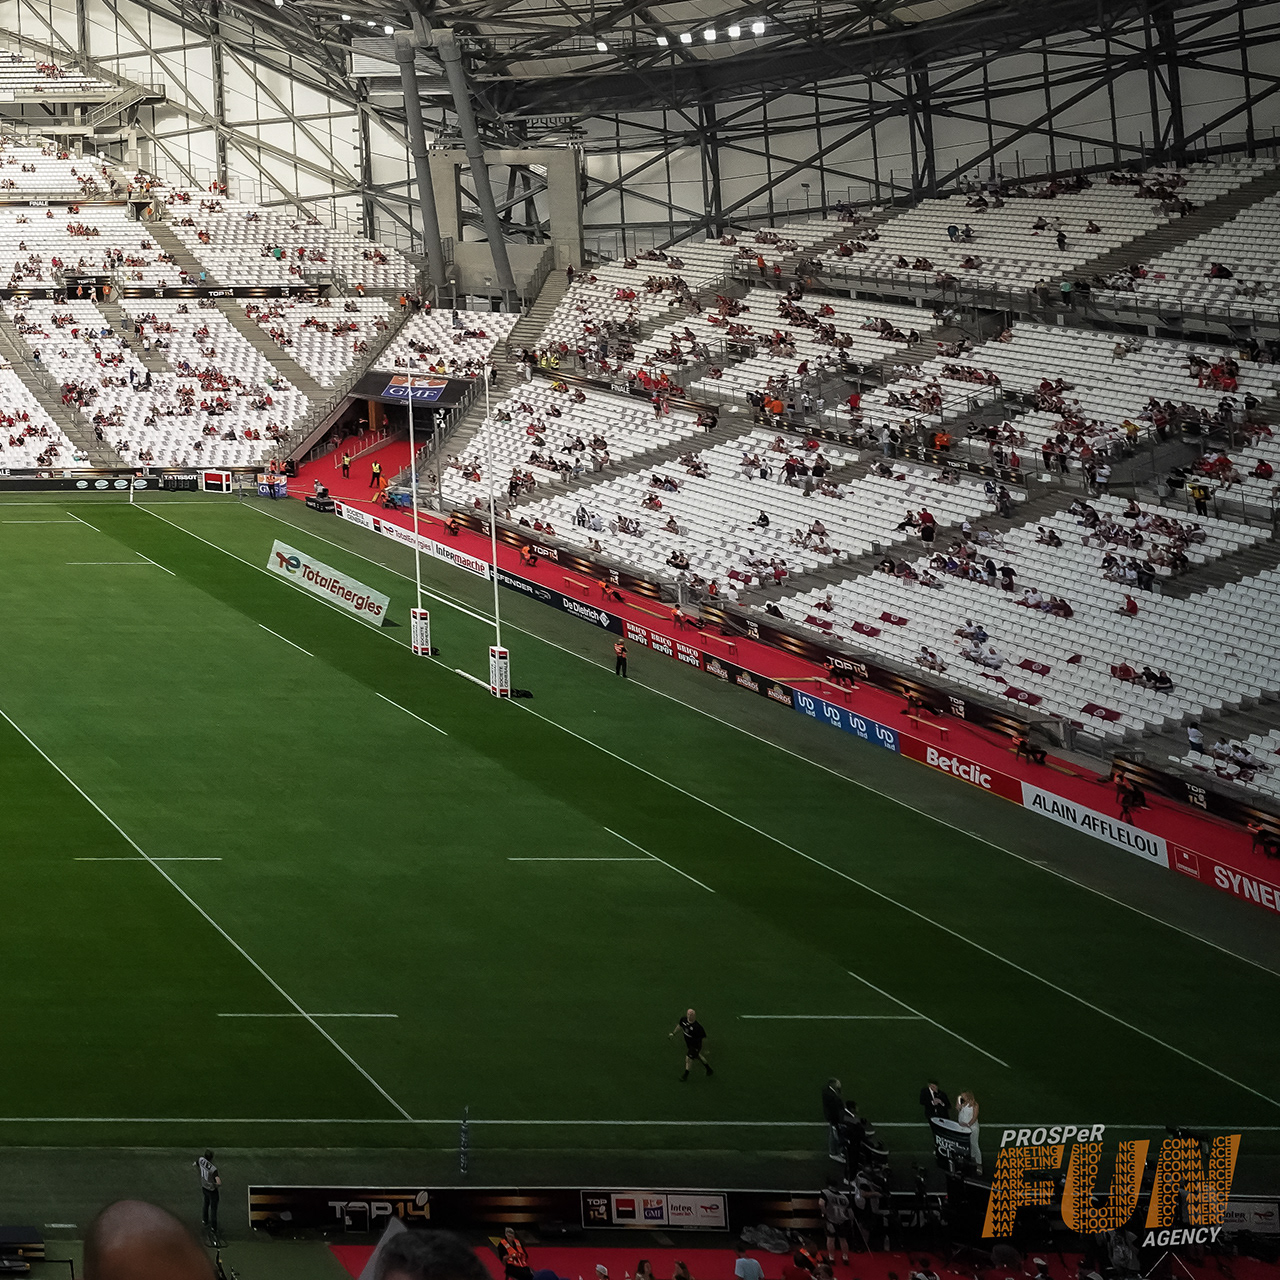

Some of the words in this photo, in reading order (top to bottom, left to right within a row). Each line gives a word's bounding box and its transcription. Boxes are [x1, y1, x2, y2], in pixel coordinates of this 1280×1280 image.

[389, 387, 437, 398] GMF
[302, 563, 383, 617] TotalEnergies
[626, 622, 647, 636] BRICO
[627, 631, 649, 646] DEPÔT
[651, 633, 672, 647] BRICO
[652, 642, 674, 657] DEPÔT
[676, 643, 699, 658] BRICO
[677, 652, 701, 668] DEPÔT
[706, 664, 728, 680] ANDROS
[736, 676, 759, 693] ANDROS
[767, 690, 791, 706] ANDROS
[948, 696, 965, 705] TOP
[951, 706, 965, 718] 14
[926, 747, 991, 789] Betclic
[1185, 782, 1206, 795] TOP
[1188, 795, 1207, 809] 14
[1032, 793, 1077, 824] ALAIN
[1080, 814, 1158, 857] AFFLELOU
[590, 1210, 607, 1220] 14
[644, 1210, 662, 1218] GMF
[671, 1204, 694, 1216] Inter
